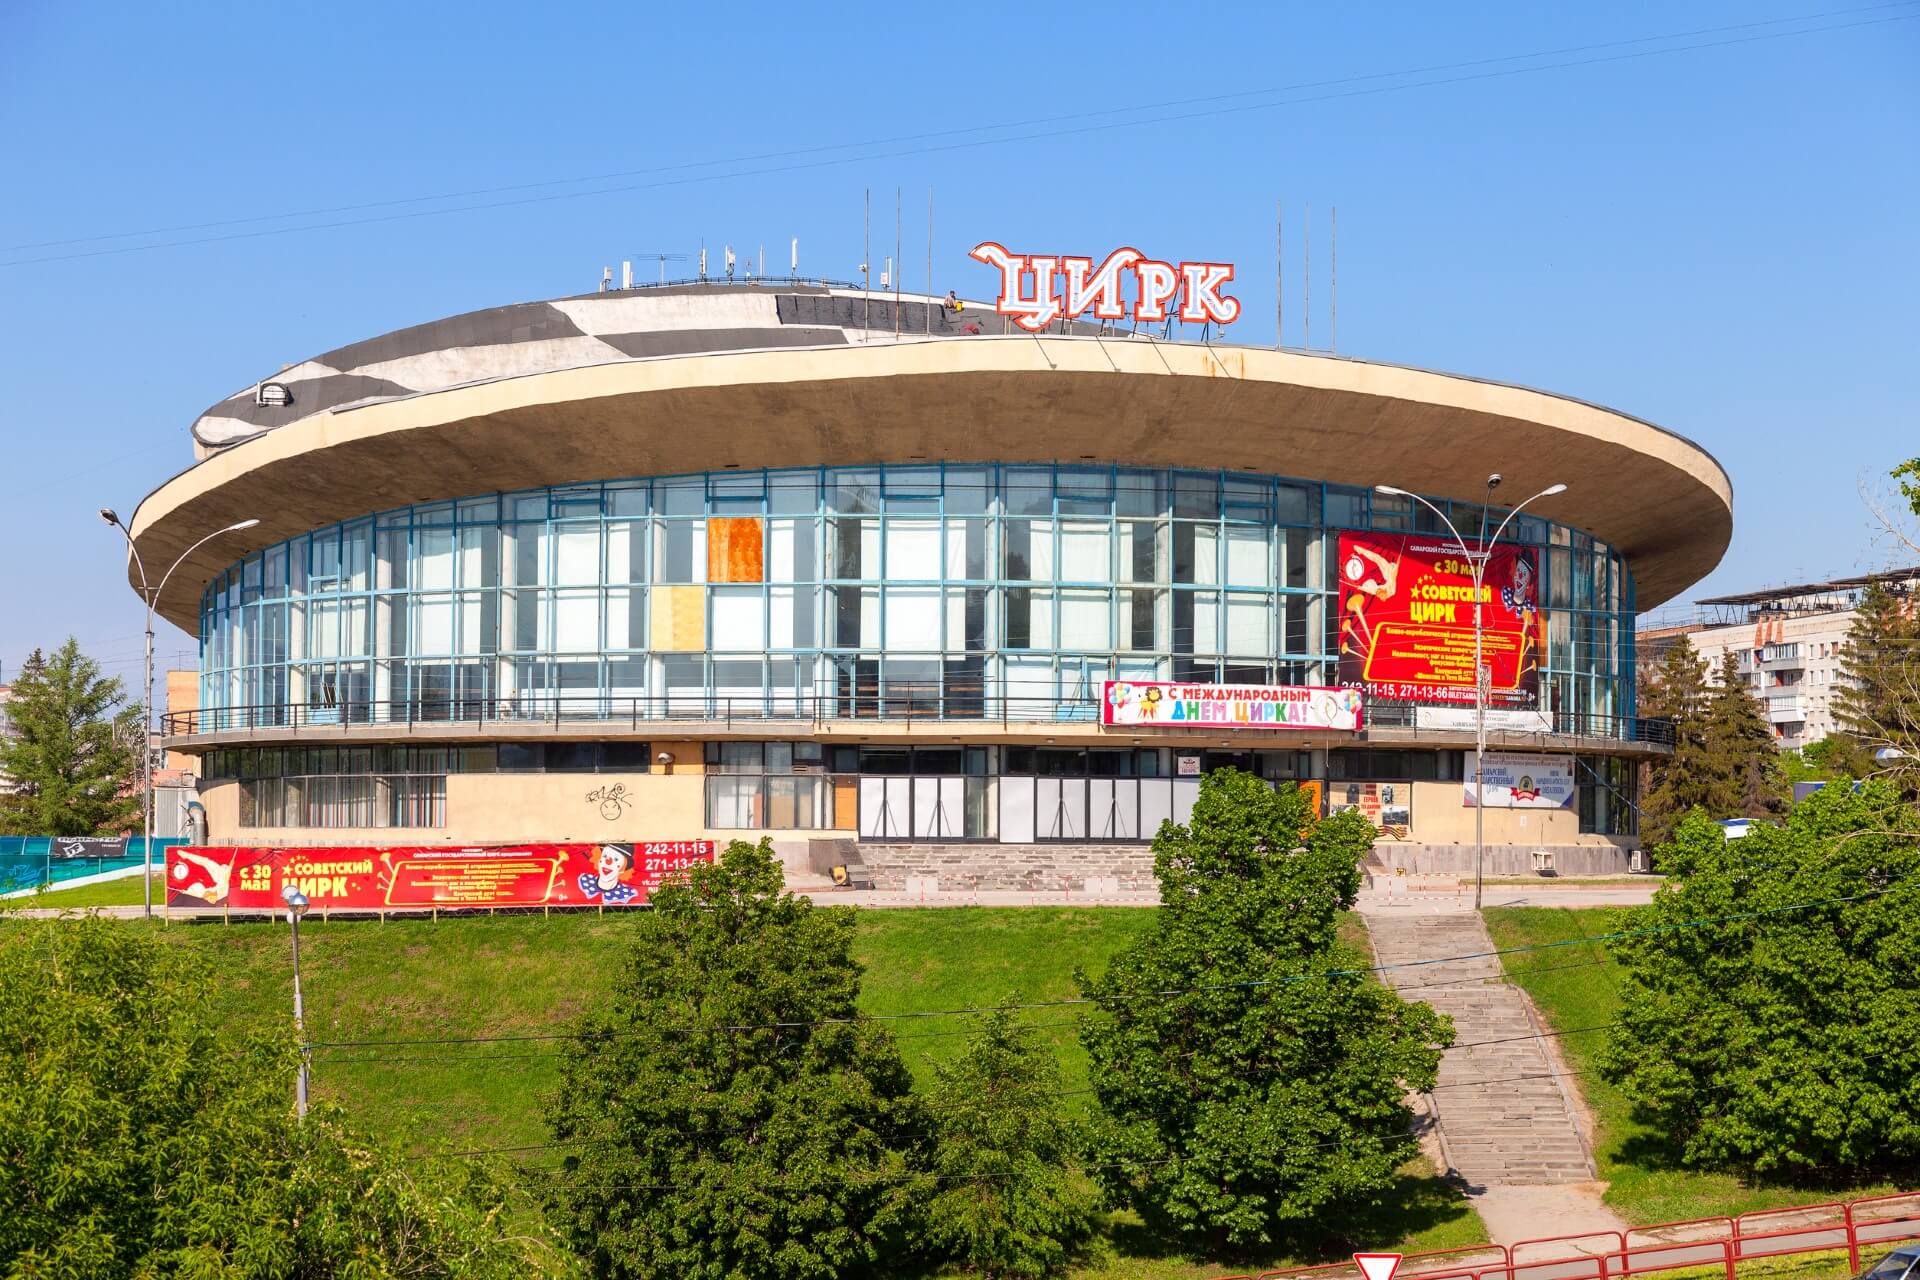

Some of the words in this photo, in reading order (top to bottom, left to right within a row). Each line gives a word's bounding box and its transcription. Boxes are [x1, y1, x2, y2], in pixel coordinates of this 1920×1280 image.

[968, 241, 1241, 331] ЦИРК
[1444, 559, 1458, 573] 30
[1410, 602, 1456, 624] ЦИРК
[1168, 688, 1178, 700] С
[1182, 689, 1311, 702] МЕЖДУНАРОДНЫМ
[1399, 684, 1448, 699] 271-13-66
[1171, 701, 1227, 722] ДНЕМ
[1235, 701, 1308, 725] ЦИРКА!
[645, 842, 707, 855] 242-11-15
[240, 867, 249, 879] с
[252, 864, 272, 879] 30
[294, 859, 373, 874] СОВЕТСКИЙ
[240, 879, 271, 891] мая
